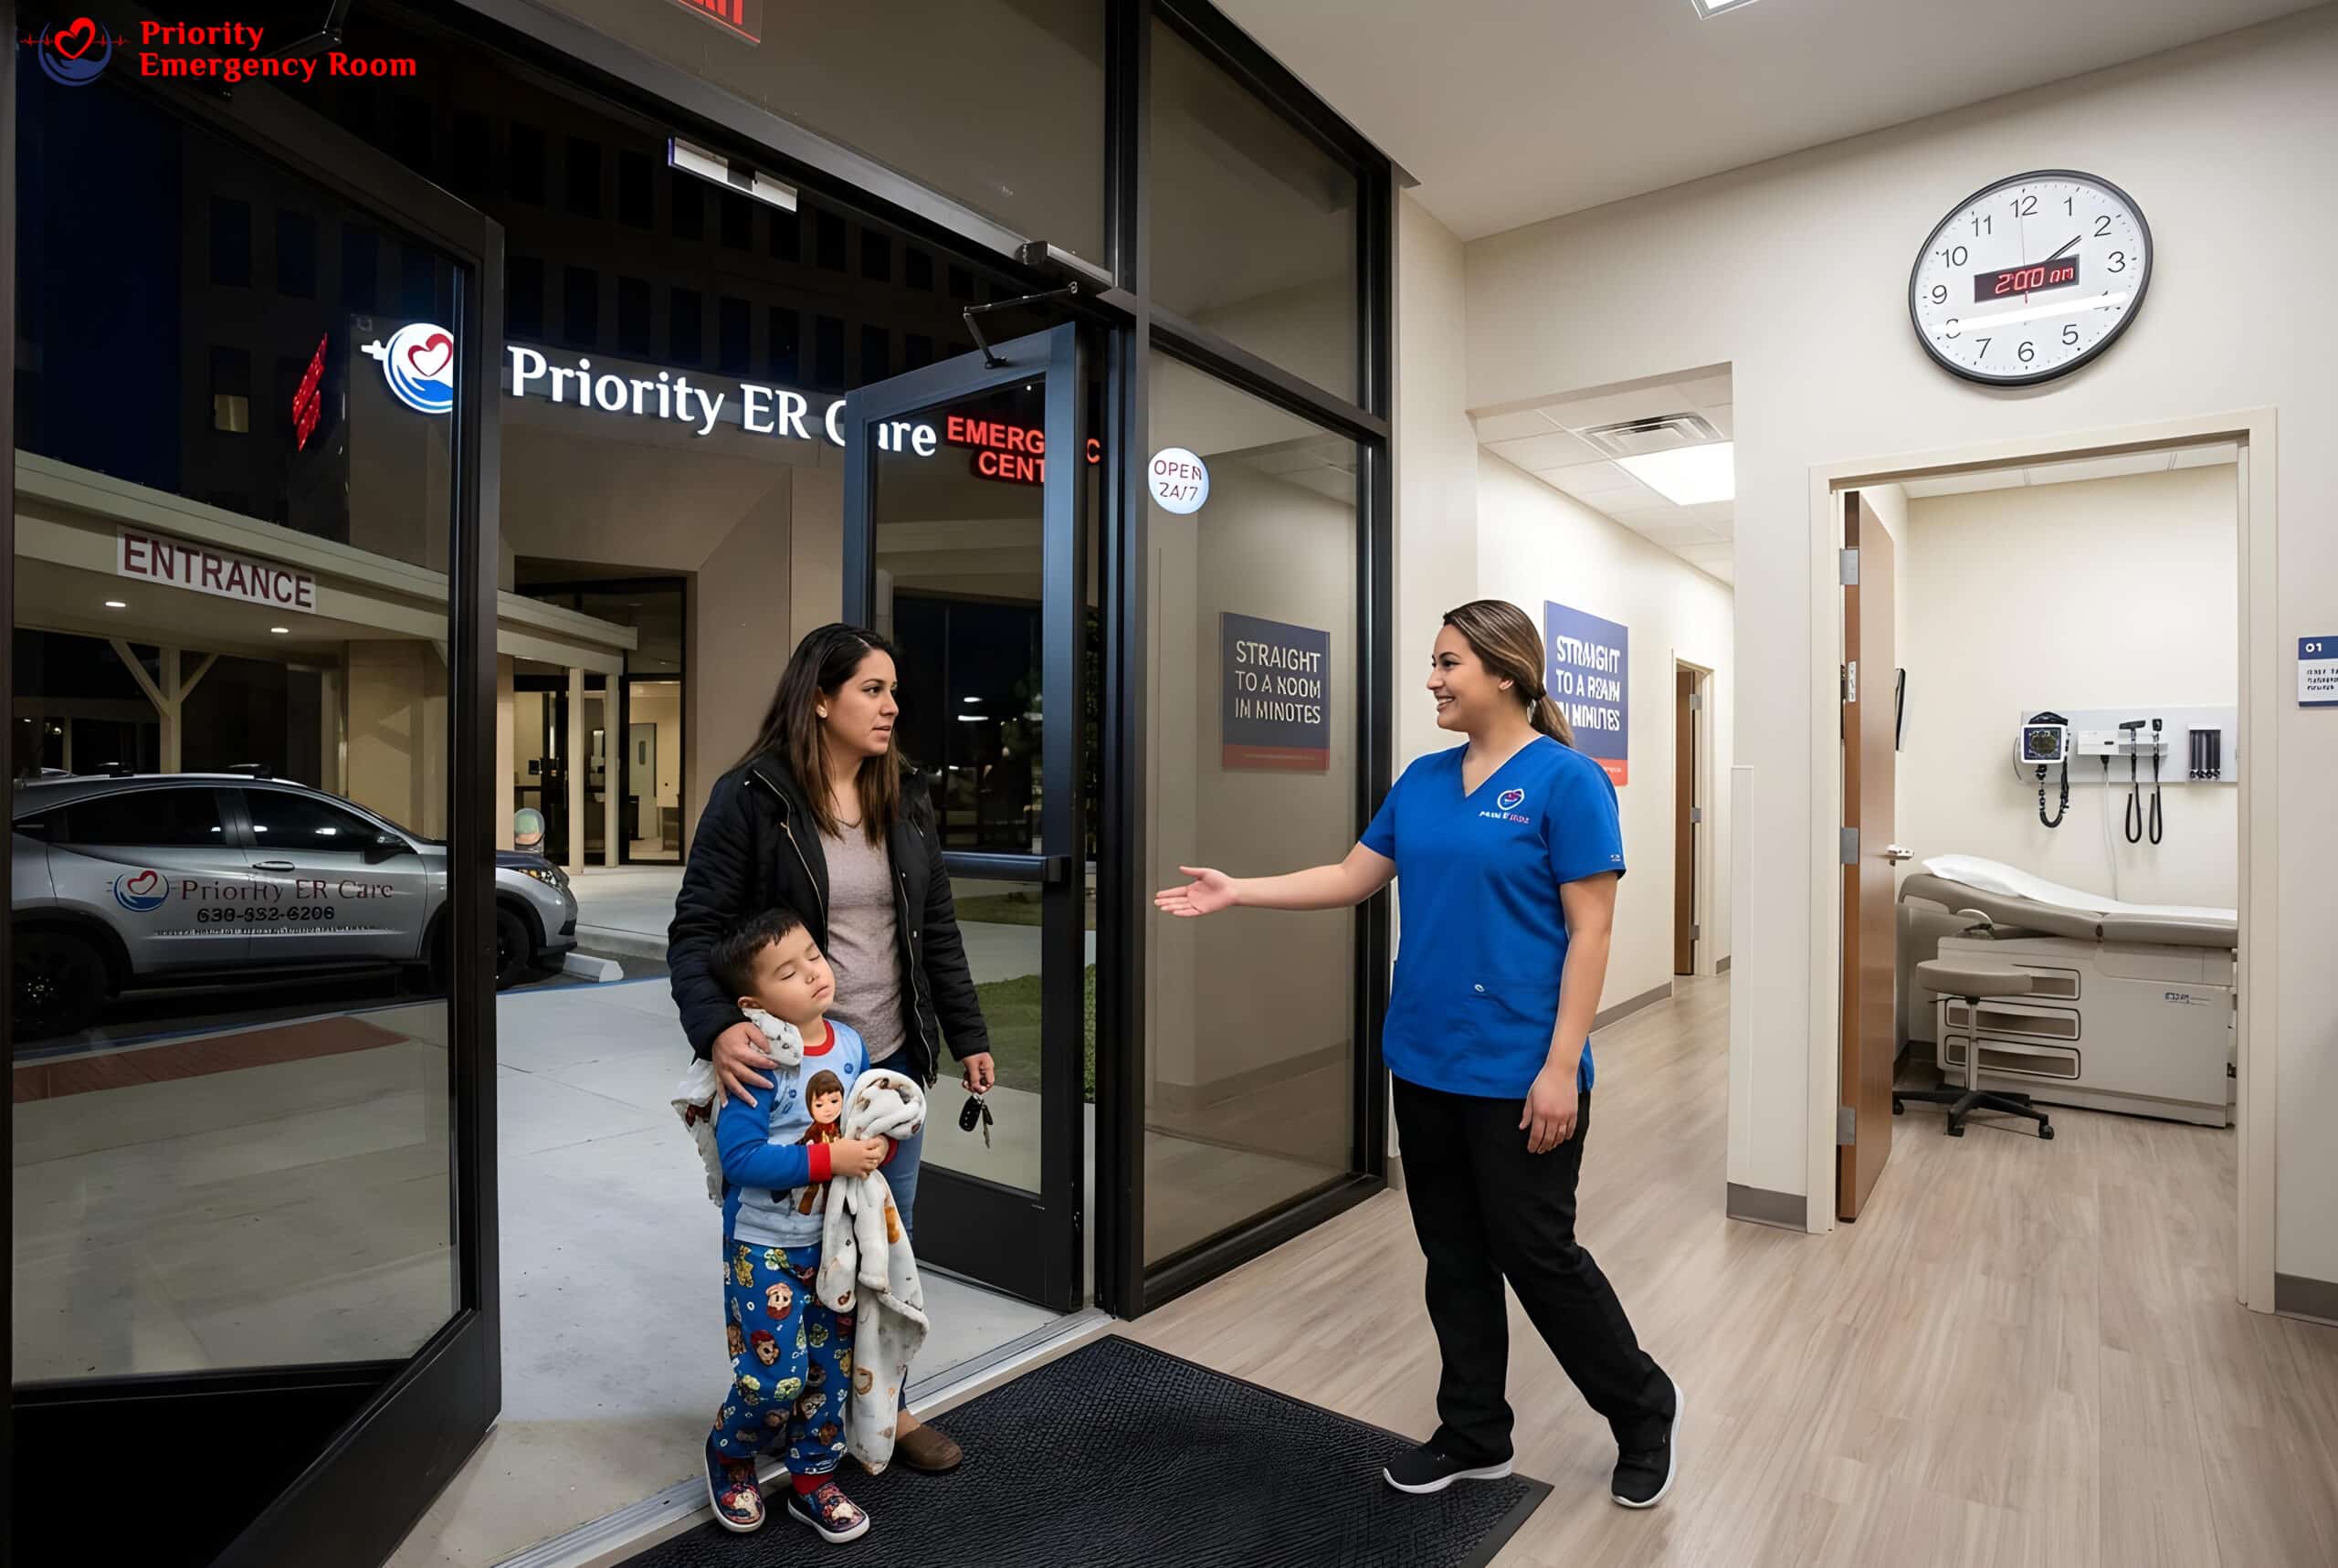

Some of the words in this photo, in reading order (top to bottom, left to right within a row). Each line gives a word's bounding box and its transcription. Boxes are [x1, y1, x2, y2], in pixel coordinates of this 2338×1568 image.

[2009, 195, 2038, 218] 12
[2063, 196, 2073, 216] 1
[1971, 215, 1992, 237] 11
[2094, 216, 2112, 237] 2
[1941, 246, 1968, 268] 10
[2107, 251, 2126, 273] 3
[1932, 285, 1948, 305] 9
[2062, 324, 2079, 344] 5
[1975, 338, 1992, 358] 7
[2018, 342, 2034, 362] 6
[507, 345, 725, 435] Priority
[740, 384, 811, 439] ER
[979, 451, 1045, 483] CENT
[1154, 459, 1202, 481] OPEN
[124, 533, 312, 608] ENTRANCE
[1236, 640, 1321, 672] STRAIGHT
[1235, 670, 1257, 691] TO
[1261, 674, 1272, 693] A
[1556, 668, 1573, 695] TO
[1576, 674, 1585, 697] A
[296, 879, 328, 900] ER
